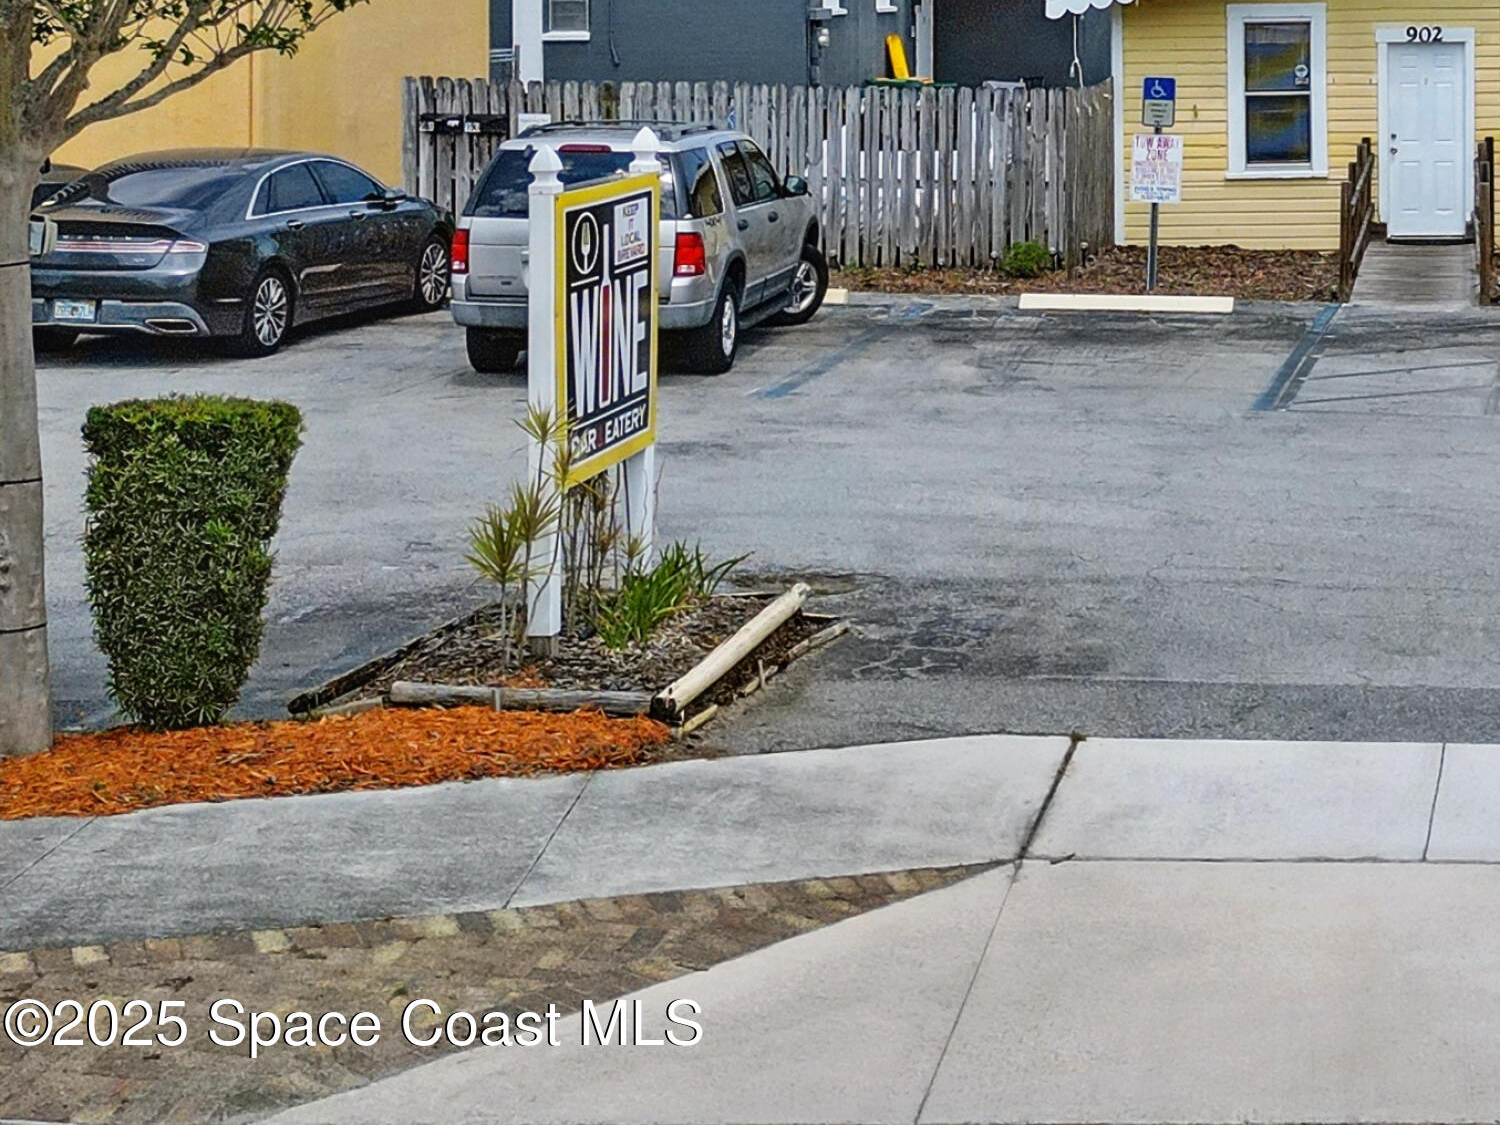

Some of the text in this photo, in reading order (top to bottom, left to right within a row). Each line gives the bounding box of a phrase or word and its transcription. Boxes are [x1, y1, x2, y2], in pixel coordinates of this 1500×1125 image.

[1406, 26, 1443, 43] 902
[570, 224, 649, 418] WINE
[605, 403, 647, 444] EATERY
